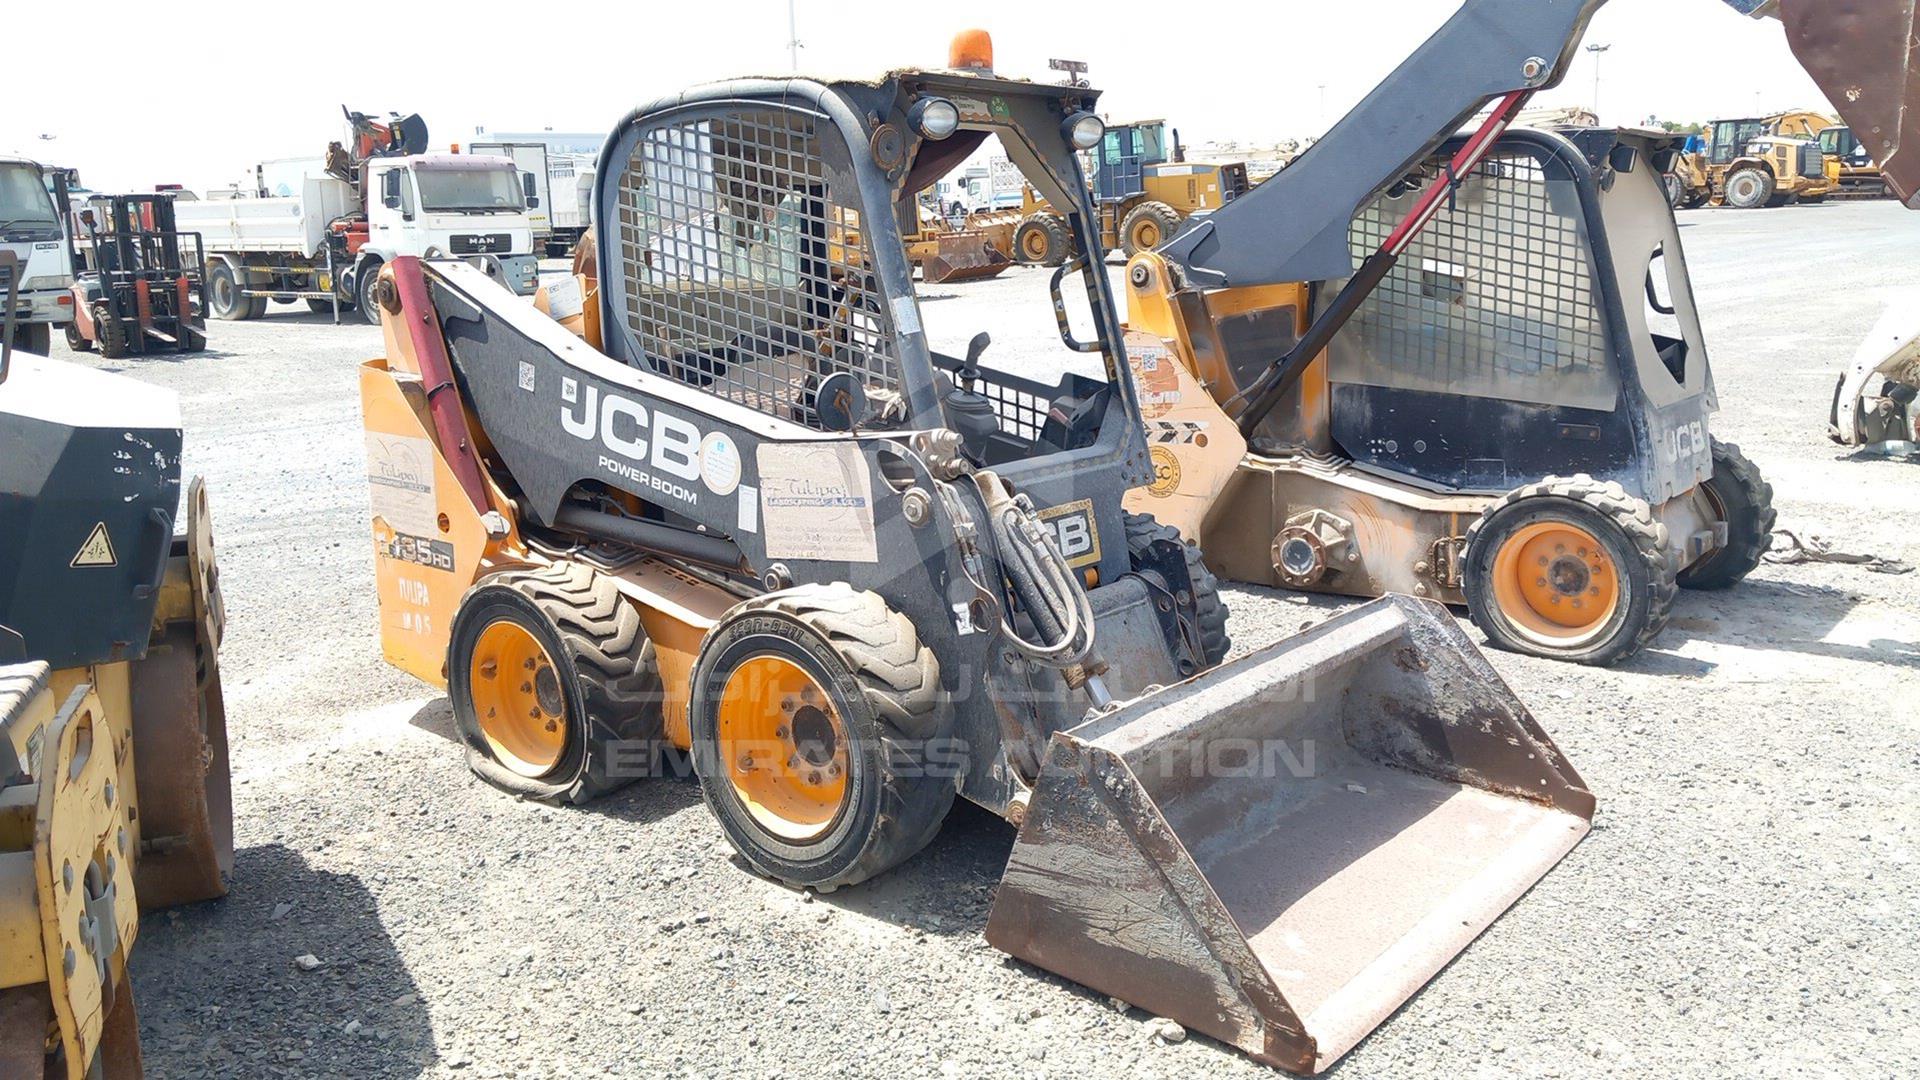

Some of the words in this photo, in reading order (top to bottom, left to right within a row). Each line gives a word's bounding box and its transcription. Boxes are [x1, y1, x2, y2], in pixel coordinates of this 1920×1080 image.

[468, 237, 495, 245] MAN
[561, 383, 701, 481] JCB
[1663, 421, 1706, 463] JCB
[784, 478, 846, 498] Tulipa
